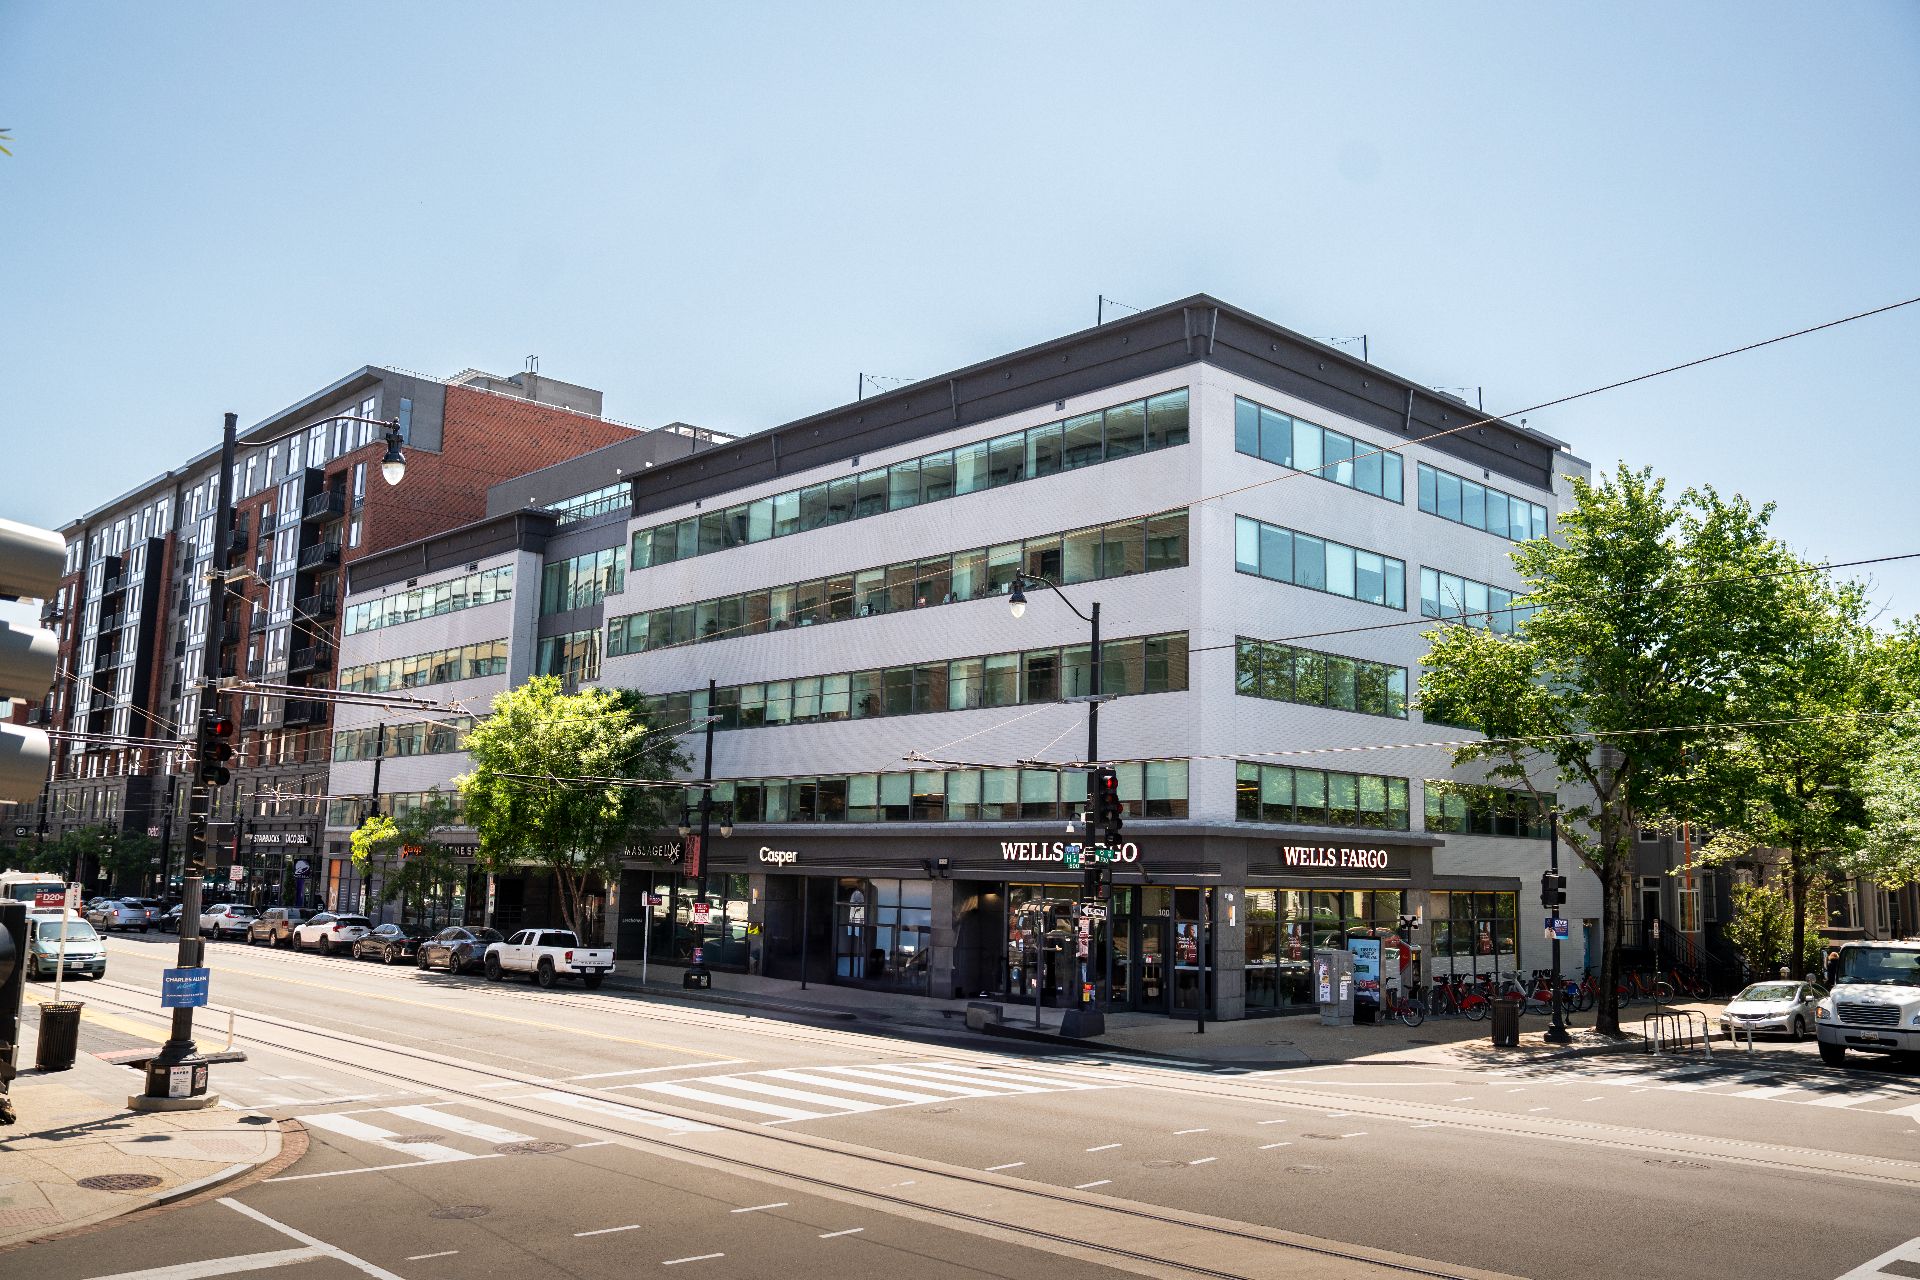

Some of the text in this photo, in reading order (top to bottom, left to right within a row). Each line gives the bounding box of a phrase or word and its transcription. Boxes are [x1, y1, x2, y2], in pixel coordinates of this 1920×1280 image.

[253, 834, 280, 843] STARBUCKS
[285, 833, 308, 844] TACO BELL
[760, 846, 798, 867] Casper
[1001, 842, 1064, 862] WELLS
[1283, 846, 1388, 869] WELLS FARGO
[1066, 854, 1072, 863] H
[43, 893, 60, 901] D20
